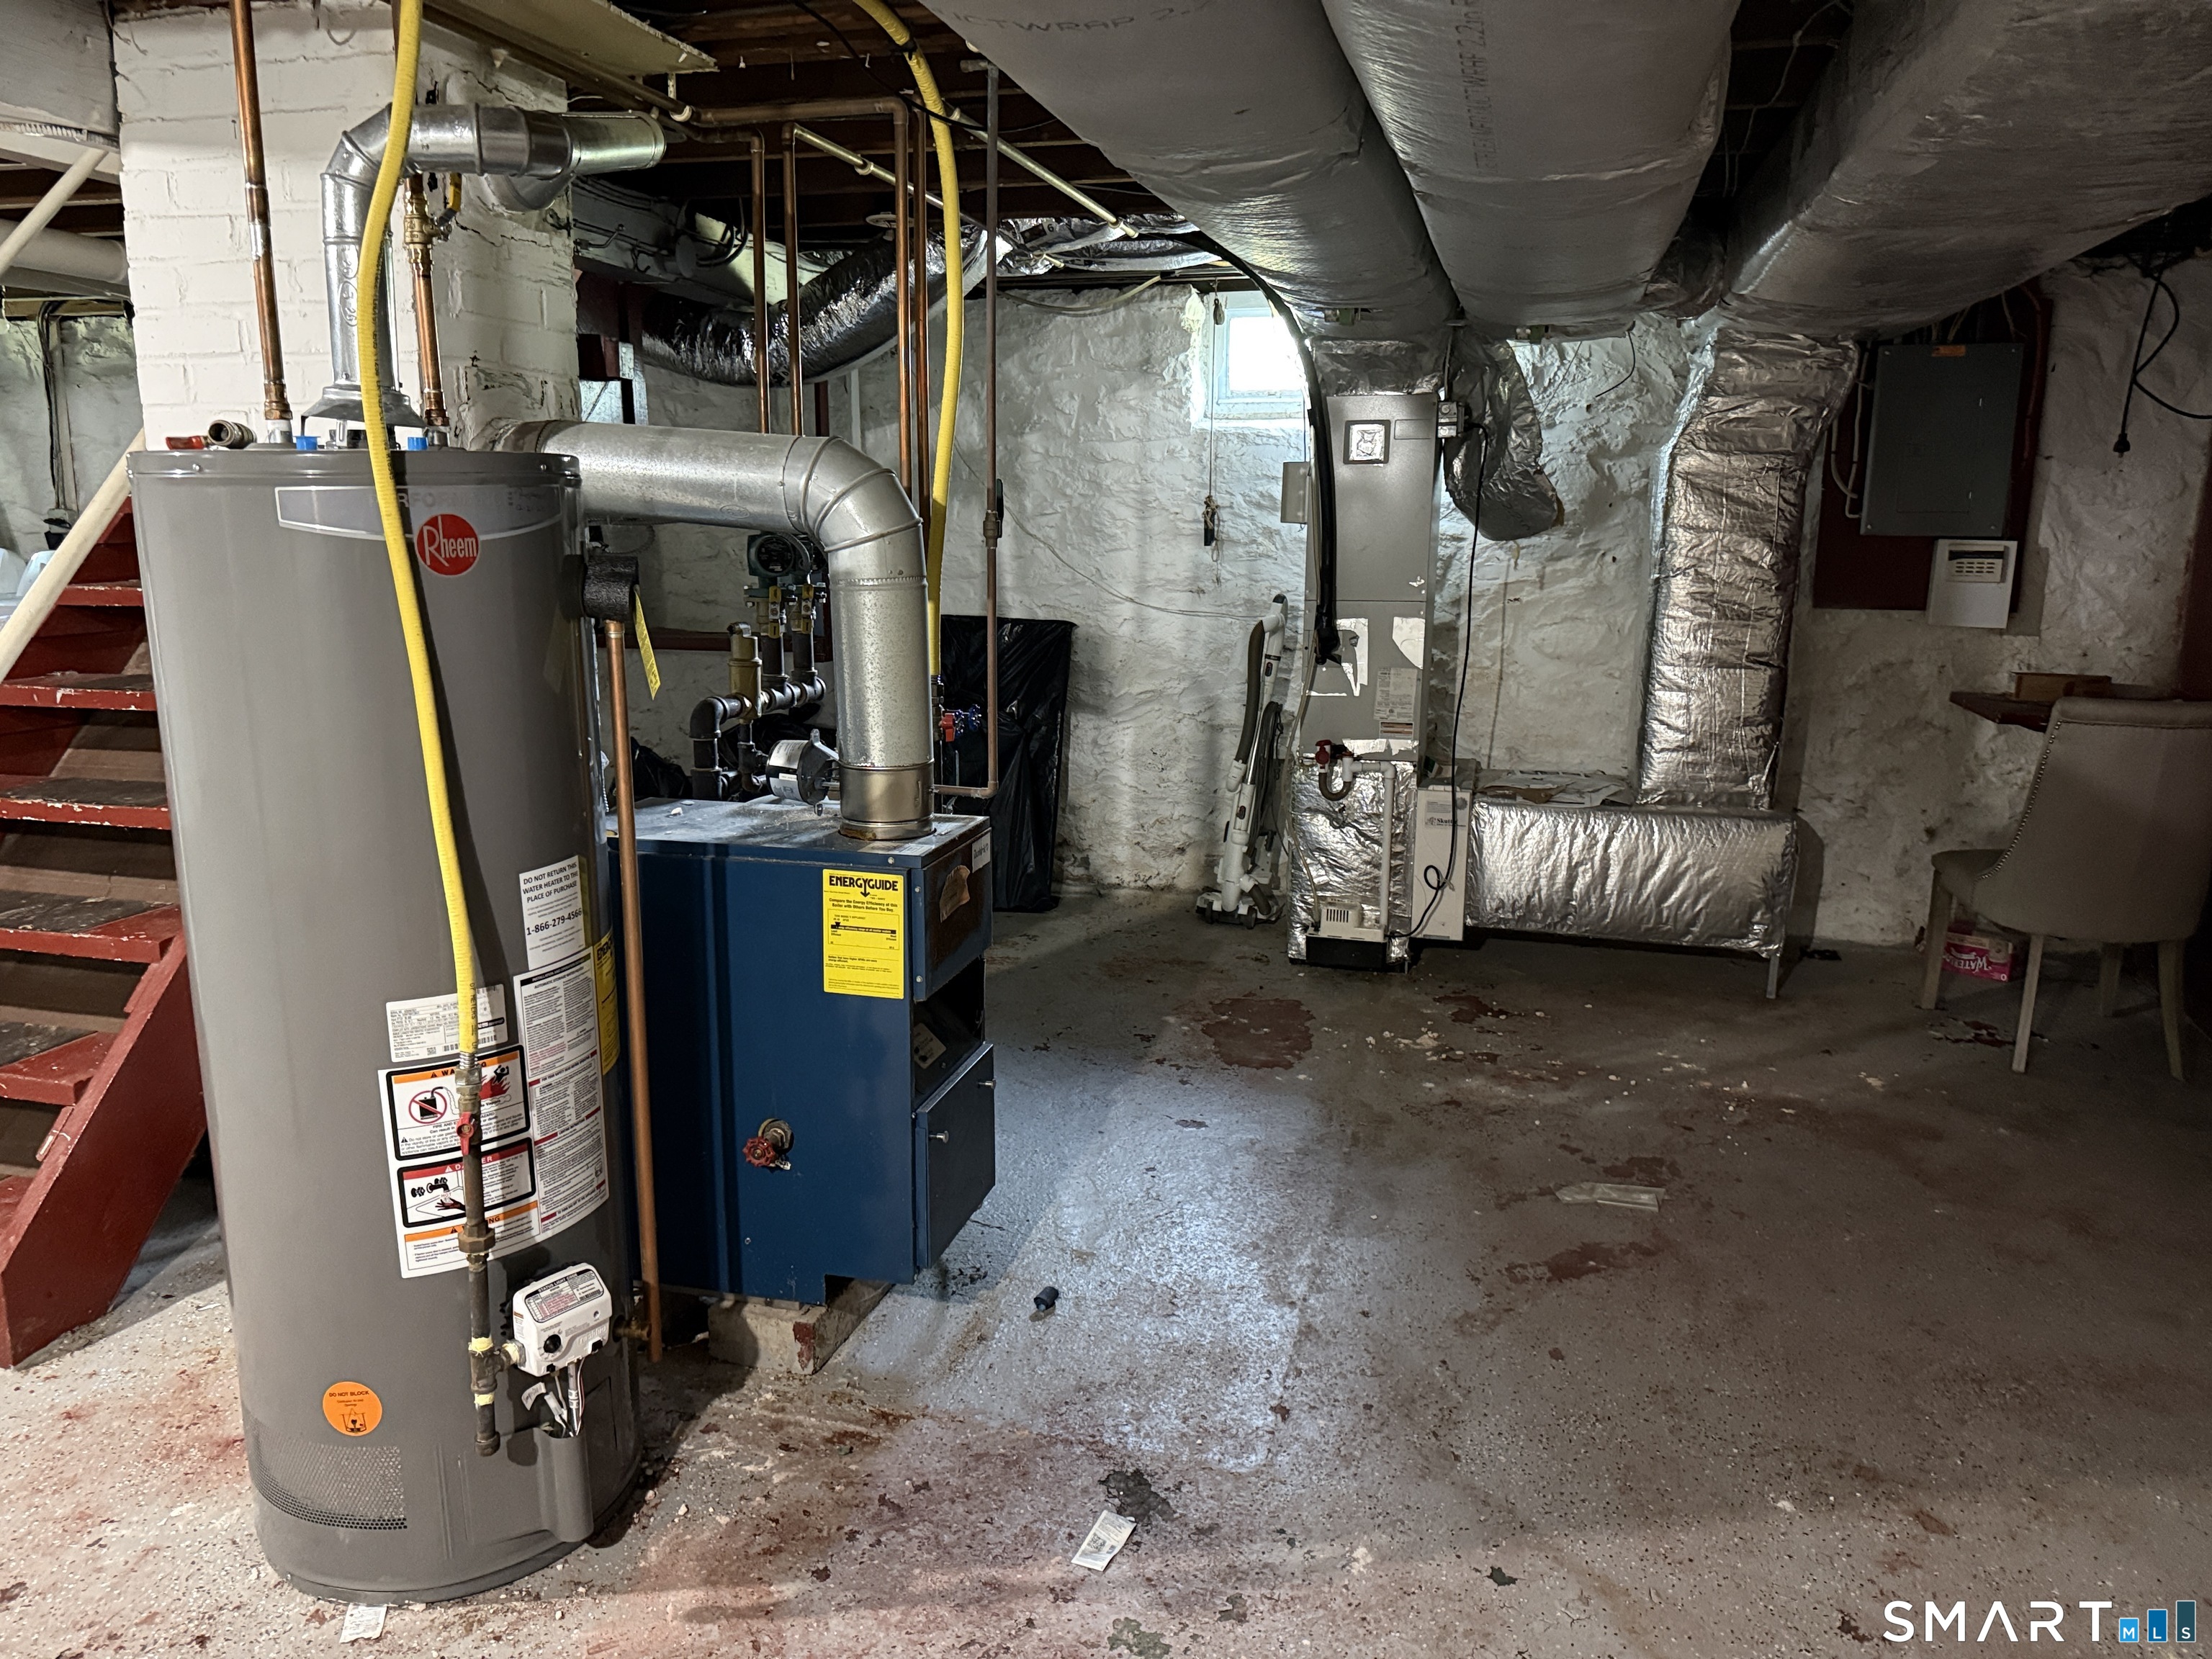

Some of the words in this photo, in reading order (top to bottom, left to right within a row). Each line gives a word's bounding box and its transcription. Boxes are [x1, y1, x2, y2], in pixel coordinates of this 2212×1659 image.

[423, 515, 477, 567] Rheem
[534, 873, 546, 881] NOT
[547, 866, 567, 878] RETURN
[567, 862, 577, 871] THIS
[523, 884, 543, 894] WATER
[544, 878, 563, 889] HEATER
[527, 893, 544, 903] PLACE
[554, 880, 577, 894] PURCHASE
[829, 876, 898, 891] ENERGYGUIDE
[526, 907, 583, 935] 1-866-279-4566
[538, 1284, 554, 1292] STATUS
